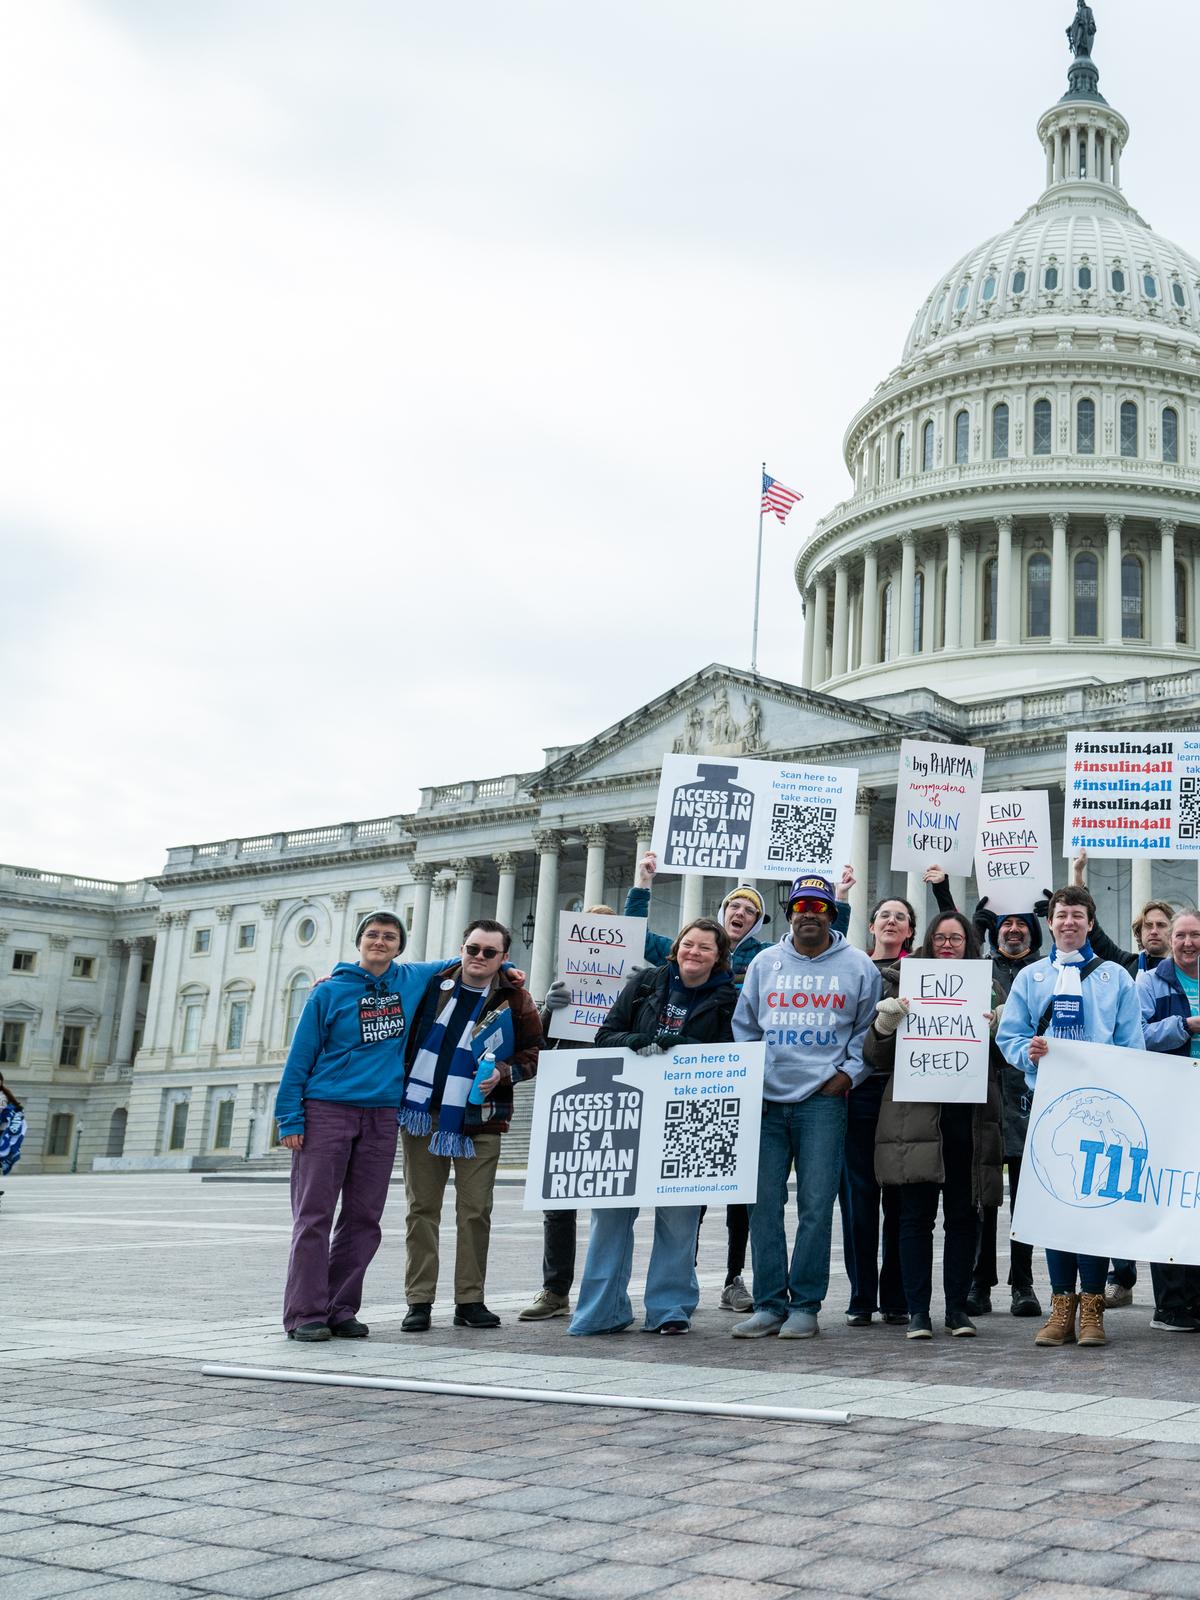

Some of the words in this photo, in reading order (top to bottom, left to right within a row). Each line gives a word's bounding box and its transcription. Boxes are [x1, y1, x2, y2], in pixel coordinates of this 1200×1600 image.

[1075, 741, 1173, 755] #insulin4all
[1177, 753, 1200, 761] learn
[913, 756, 928, 777] big
[931, 753, 974, 778] PHARMA
[1074, 760, 1173, 773] #insulin4all
[780, 770, 801, 779] Scan
[804, 772, 825, 782] here
[772, 780, 796, 790] learn
[798, 784, 822, 792] more
[825, 785, 842, 794] and
[909, 782, 966, 797] ringmasters
[1073, 779, 1172, 792] #insulin4all
[676, 788, 728, 804] ACCESS
[732, 792, 752, 806] TO
[781, 793, 802, 802] take
[803, 795, 832, 804] action
[929, 793, 941, 807] of
[672, 801, 751, 821] INSULIN
[990, 803, 1022, 820] END
[1072, 798, 1172, 811] #insulin4all
[692, 818, 708, 832] IS
[716, 820, 727, 832] A
[907, 810, 960, 831] INSULIN
[1072, 816, 1171, 830] #insulin4all
[670, 831, 746, 850] HUMAN
[913, 833, 952, 853] GREED
[981, 830, 1038, 847] PHARMA
[1071, 836, 1171, 849] #insulin4all
[671, 847, 742, 868] RIGHT
[764, 864, 833, 875] t1international.com
[988, 861, 1030, 877] GREED
[570, 924, 624, 944] ACCESS
[567, 958, 624, 976] INSULIN
[596, 978, 602, 986] A
[776, 975, 824, 990] ELECT
[829, 976, 840, 990] A
[921, 973, 964, 998] END
[361, 994, 398, 1005] ACCESS
[767, 992, 846, 1009] CLOWN
[360, 1006, 400, 1018] INSULIN
[574, 1010, 609, 1024] RIGH
[772, 1012, 824, 1026] EXPECT
[828, 1012, 837, 1026] A
[362, 1018, 404, 1032] HUMAN
[906, 1012, 976, 1038] PHARMA
[364, 1028, 404, 1042] RIGHT
[766, 1030, 838, 1046] CIRCUS
[672, 1054, 698, 1065] Scan
[701, 1053, 725, 1064] here
[728, 1054, 740, 1062] to
[910, 1050, 969, 1072] GREED
[664, 1070, 691, 1080] learn
[694, 1070, 723, 1079] more
[726, 1067, 746, 1078] and
[674, 1086, 698, 1096] take
[700, 1084, 734, 1094] action
[552, 1092, 613, 1112] ACCESS
[618, 1092, 640, 1108] TO
[550, 1108, 640, 1132] INSULIN
[572, 1132, 590, 1150] IS
[600, 1131, 613, 1149] A
[548, 1149, 634, 1173] HUMAN
[550, 1170, 630, 1198] RIGHT
[656, 1183, 738, 1194] t1international.com
